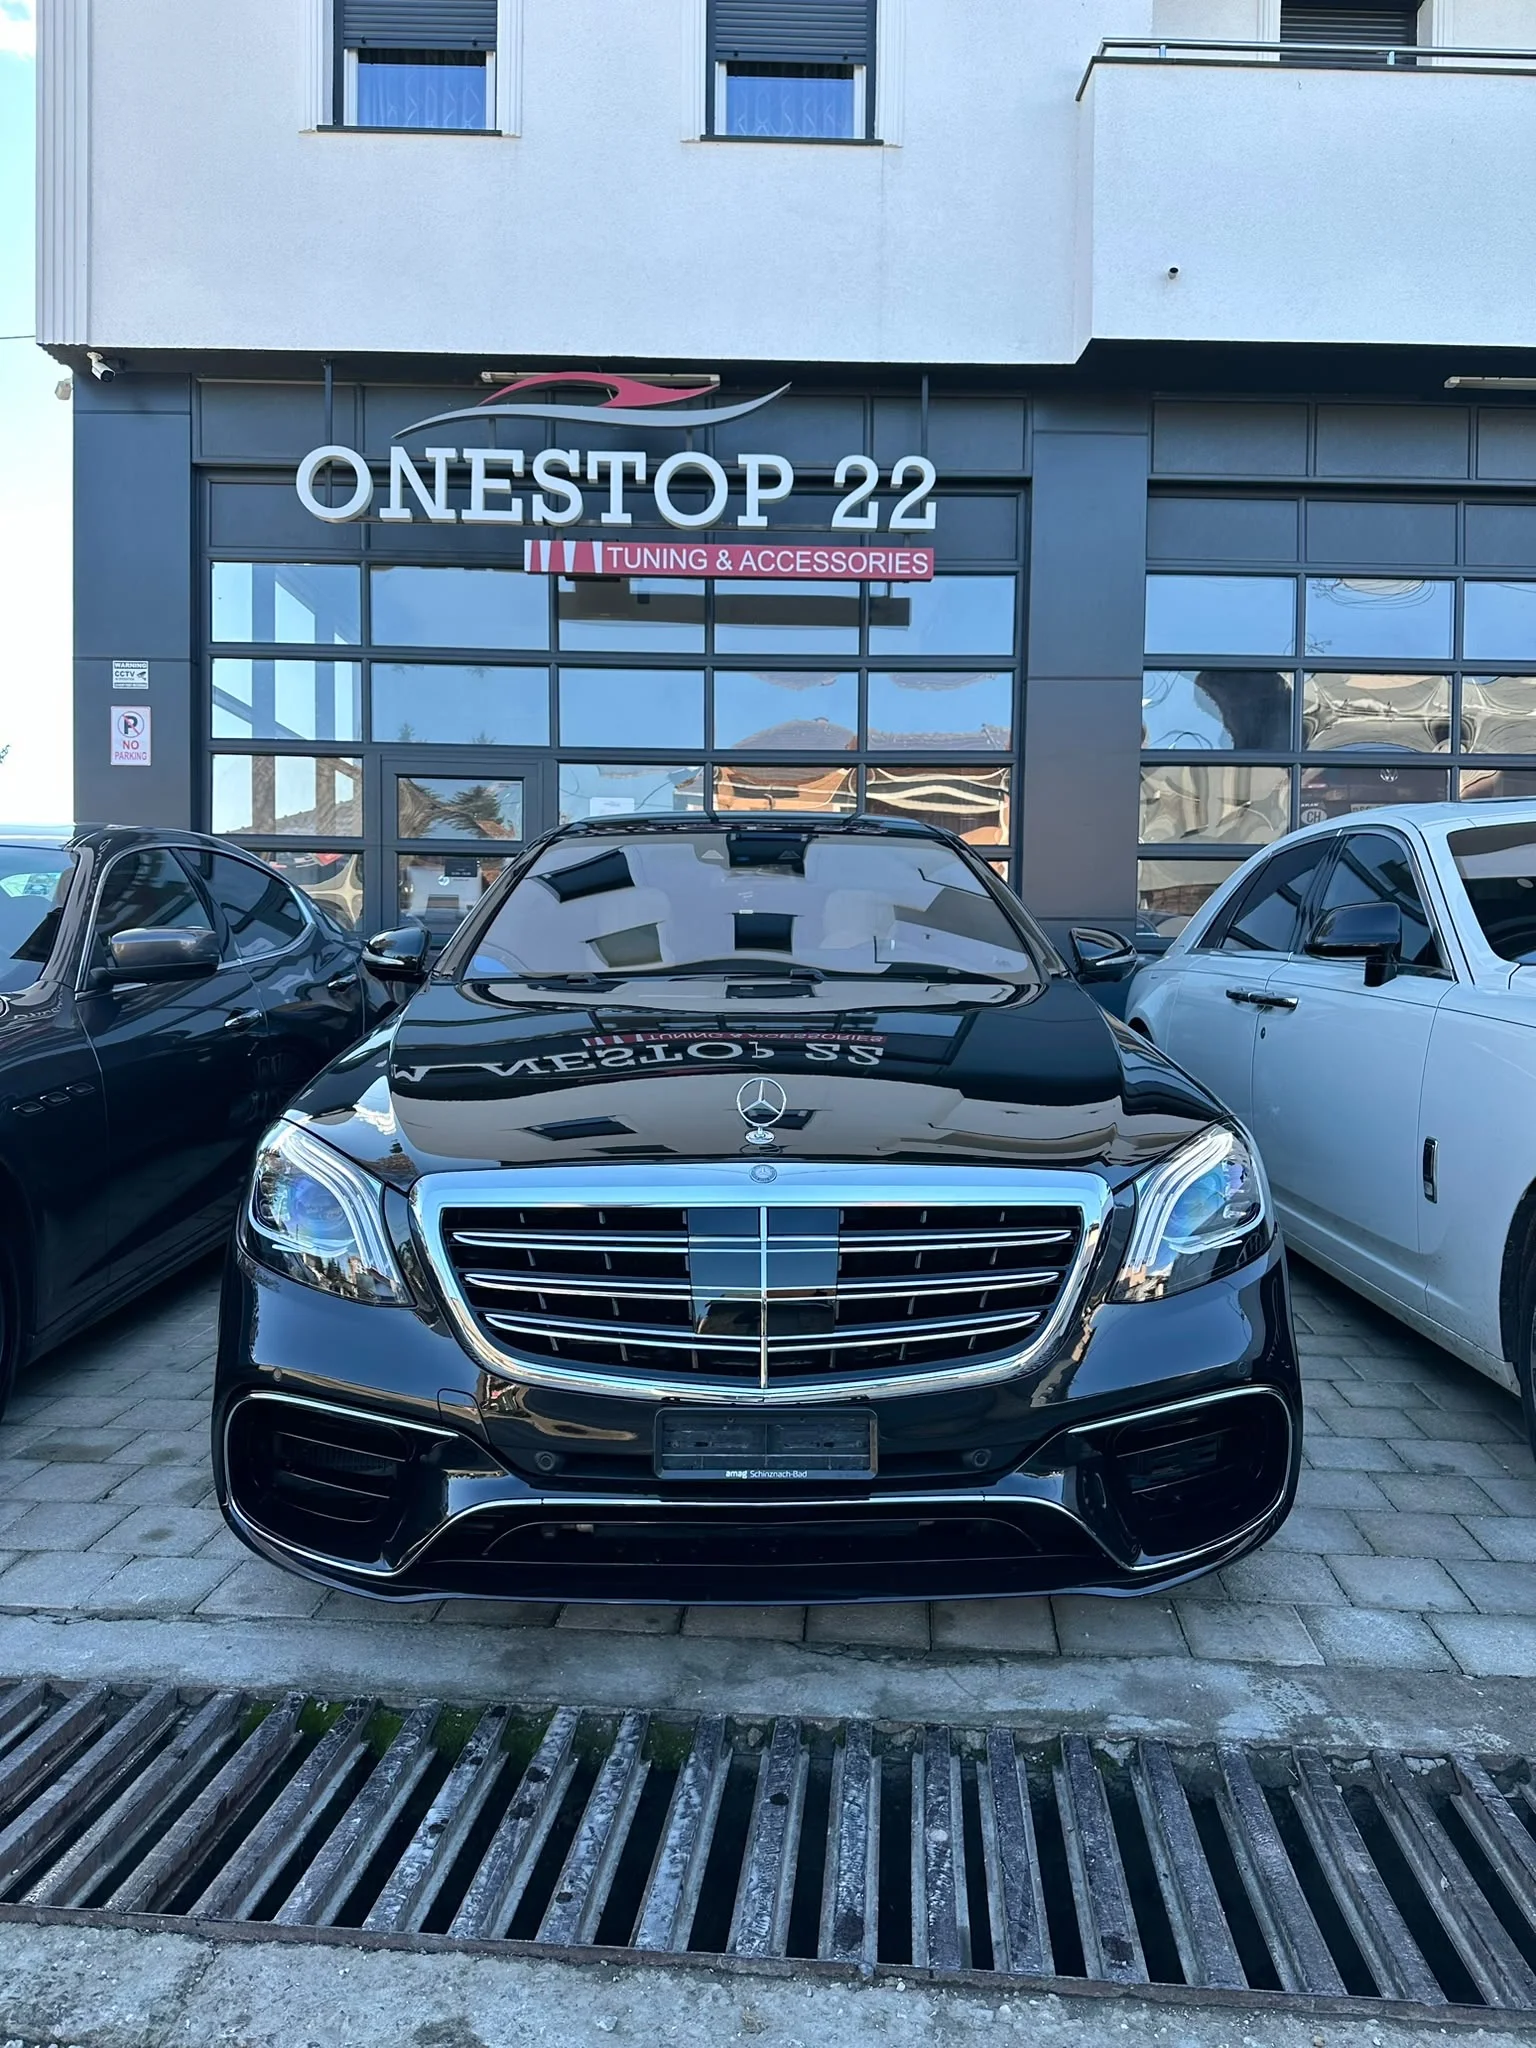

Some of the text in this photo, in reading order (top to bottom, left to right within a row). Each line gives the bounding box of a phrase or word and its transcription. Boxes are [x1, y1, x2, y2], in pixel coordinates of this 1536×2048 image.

[296, 445, 937, 531] ONESTOP 22
[607, 547, 929, 574] TUNING & ACCESSORIES
[122, 740, 139, 750] NO
[114, 751, 147, 761] PARKING
[1306, 811, 1321, 823] CH
[725, 1470, 808, 1479] amag Schinznach-Bad
